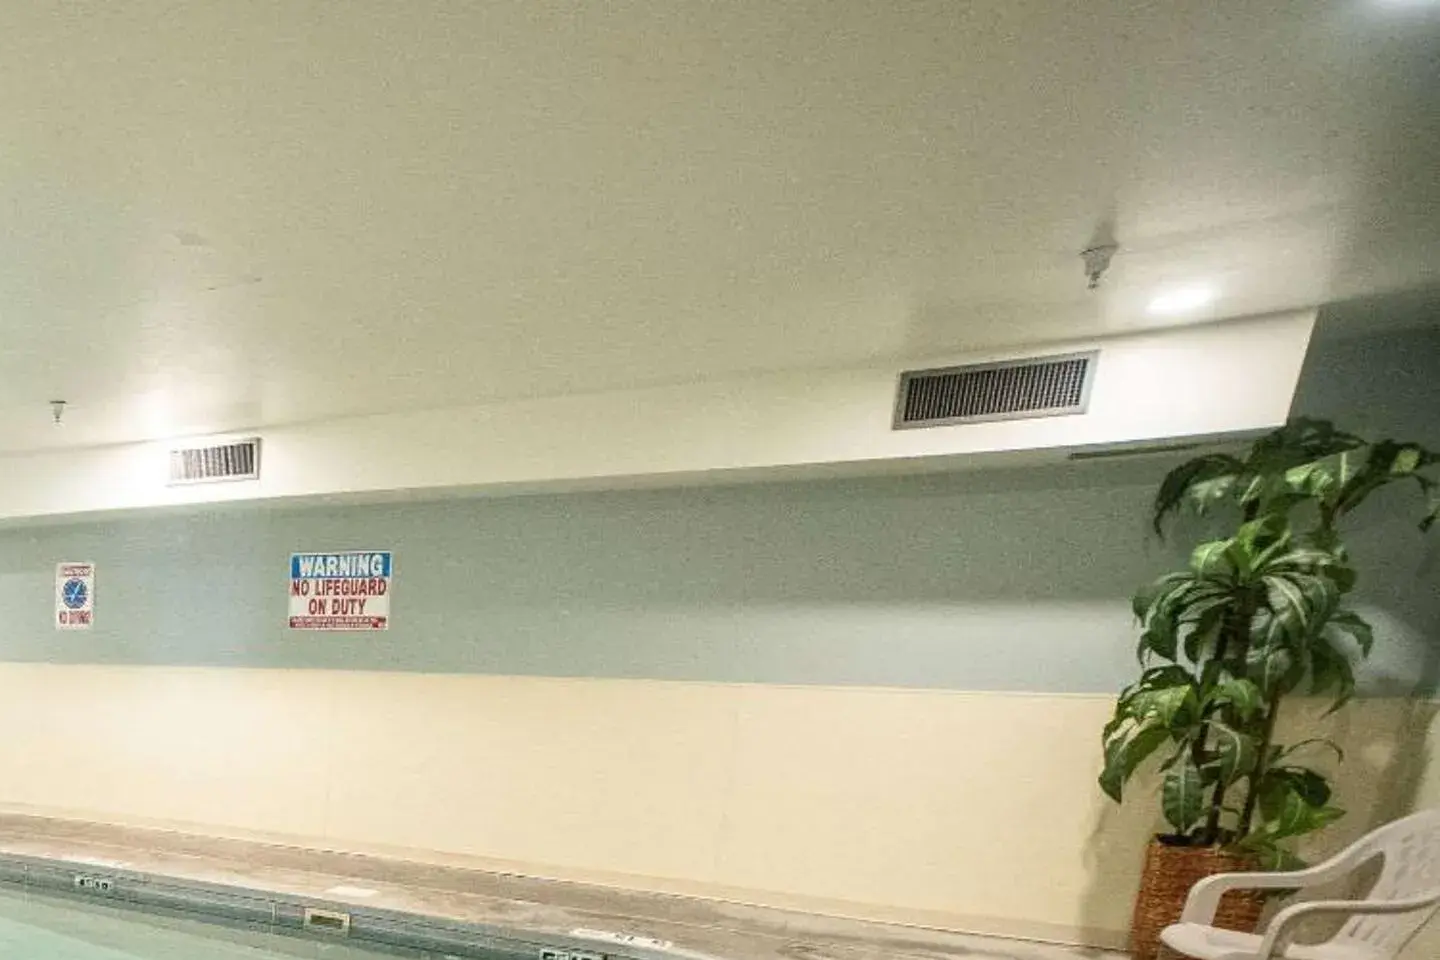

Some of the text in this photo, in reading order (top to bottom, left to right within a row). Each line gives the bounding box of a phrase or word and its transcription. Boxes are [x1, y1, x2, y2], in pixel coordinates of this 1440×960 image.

[300, 555, 384, 577] WARNING
[293, 578, 387, 596] NO LIFEGUARD
[308, 598, 366, 615] ON DUTY
